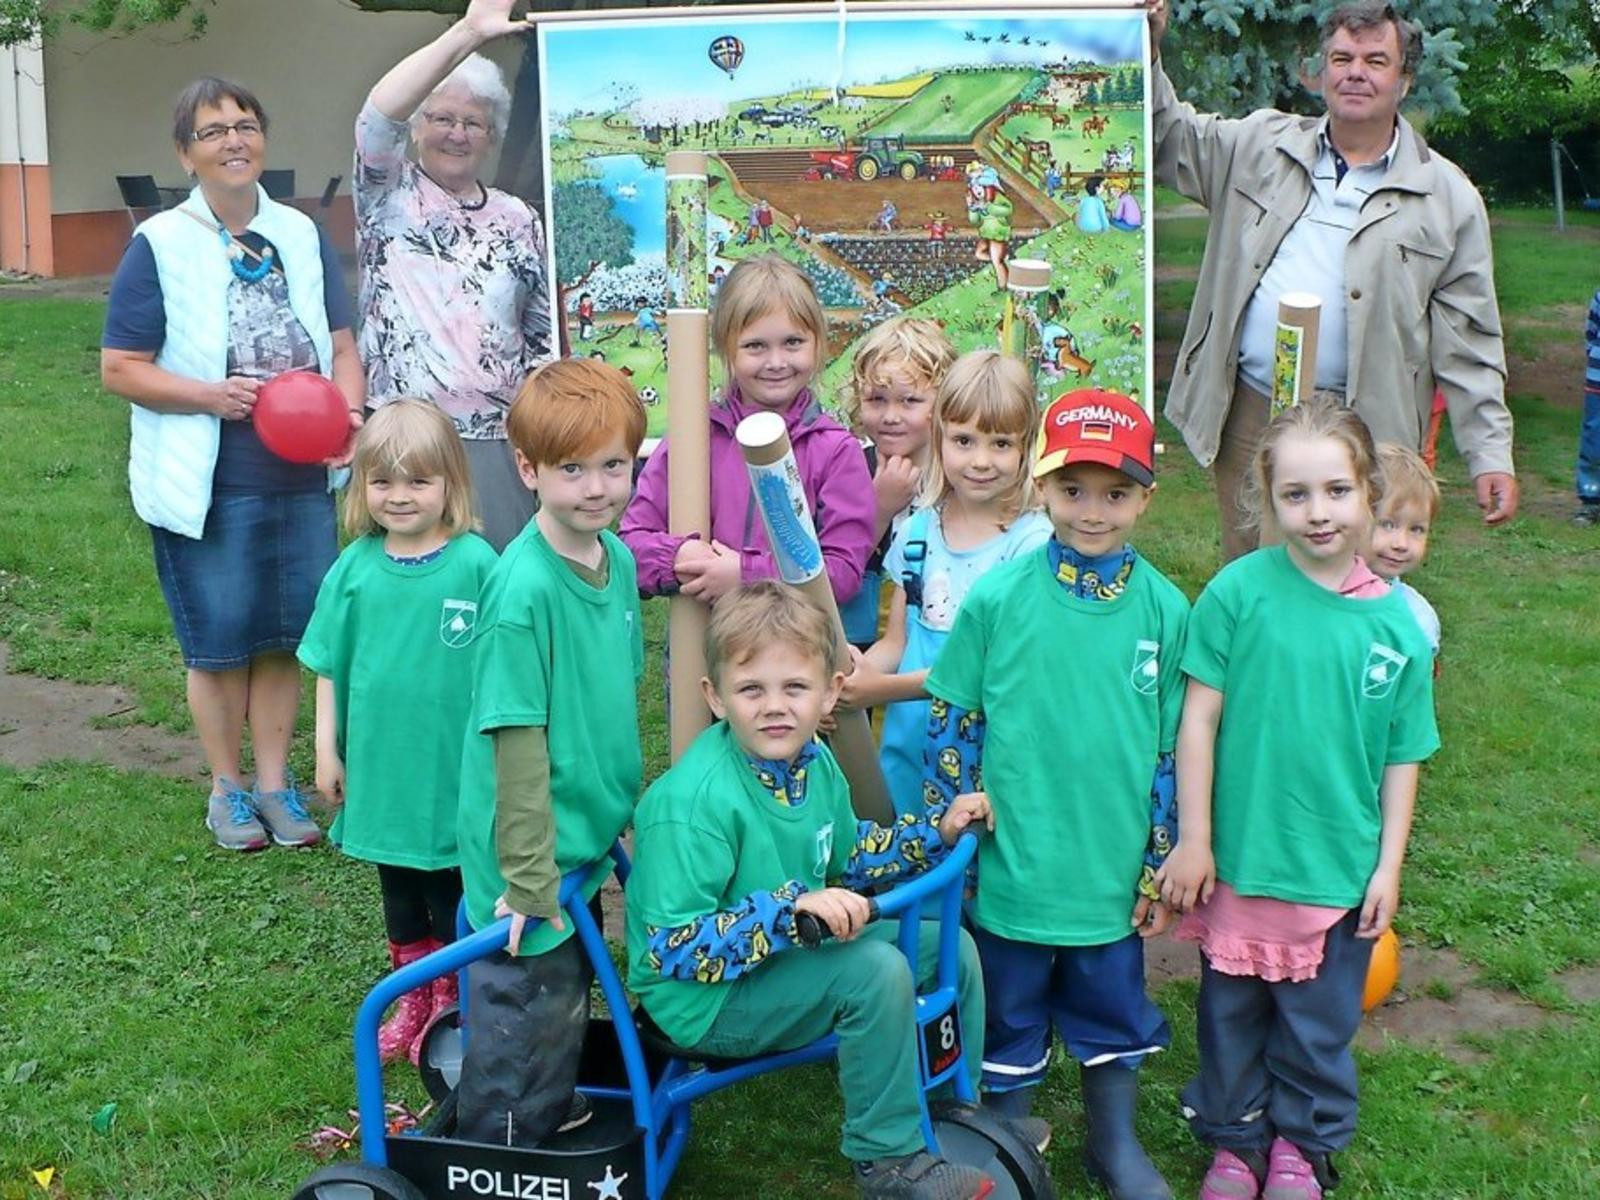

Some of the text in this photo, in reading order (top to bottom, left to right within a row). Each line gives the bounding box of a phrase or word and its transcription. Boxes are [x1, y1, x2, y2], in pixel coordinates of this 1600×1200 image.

[1056, 405, 1137, 431] GERMANY
[940, 1015, 955, 1050] 8
[447, 1165, 570, 1200] POLIZEI
